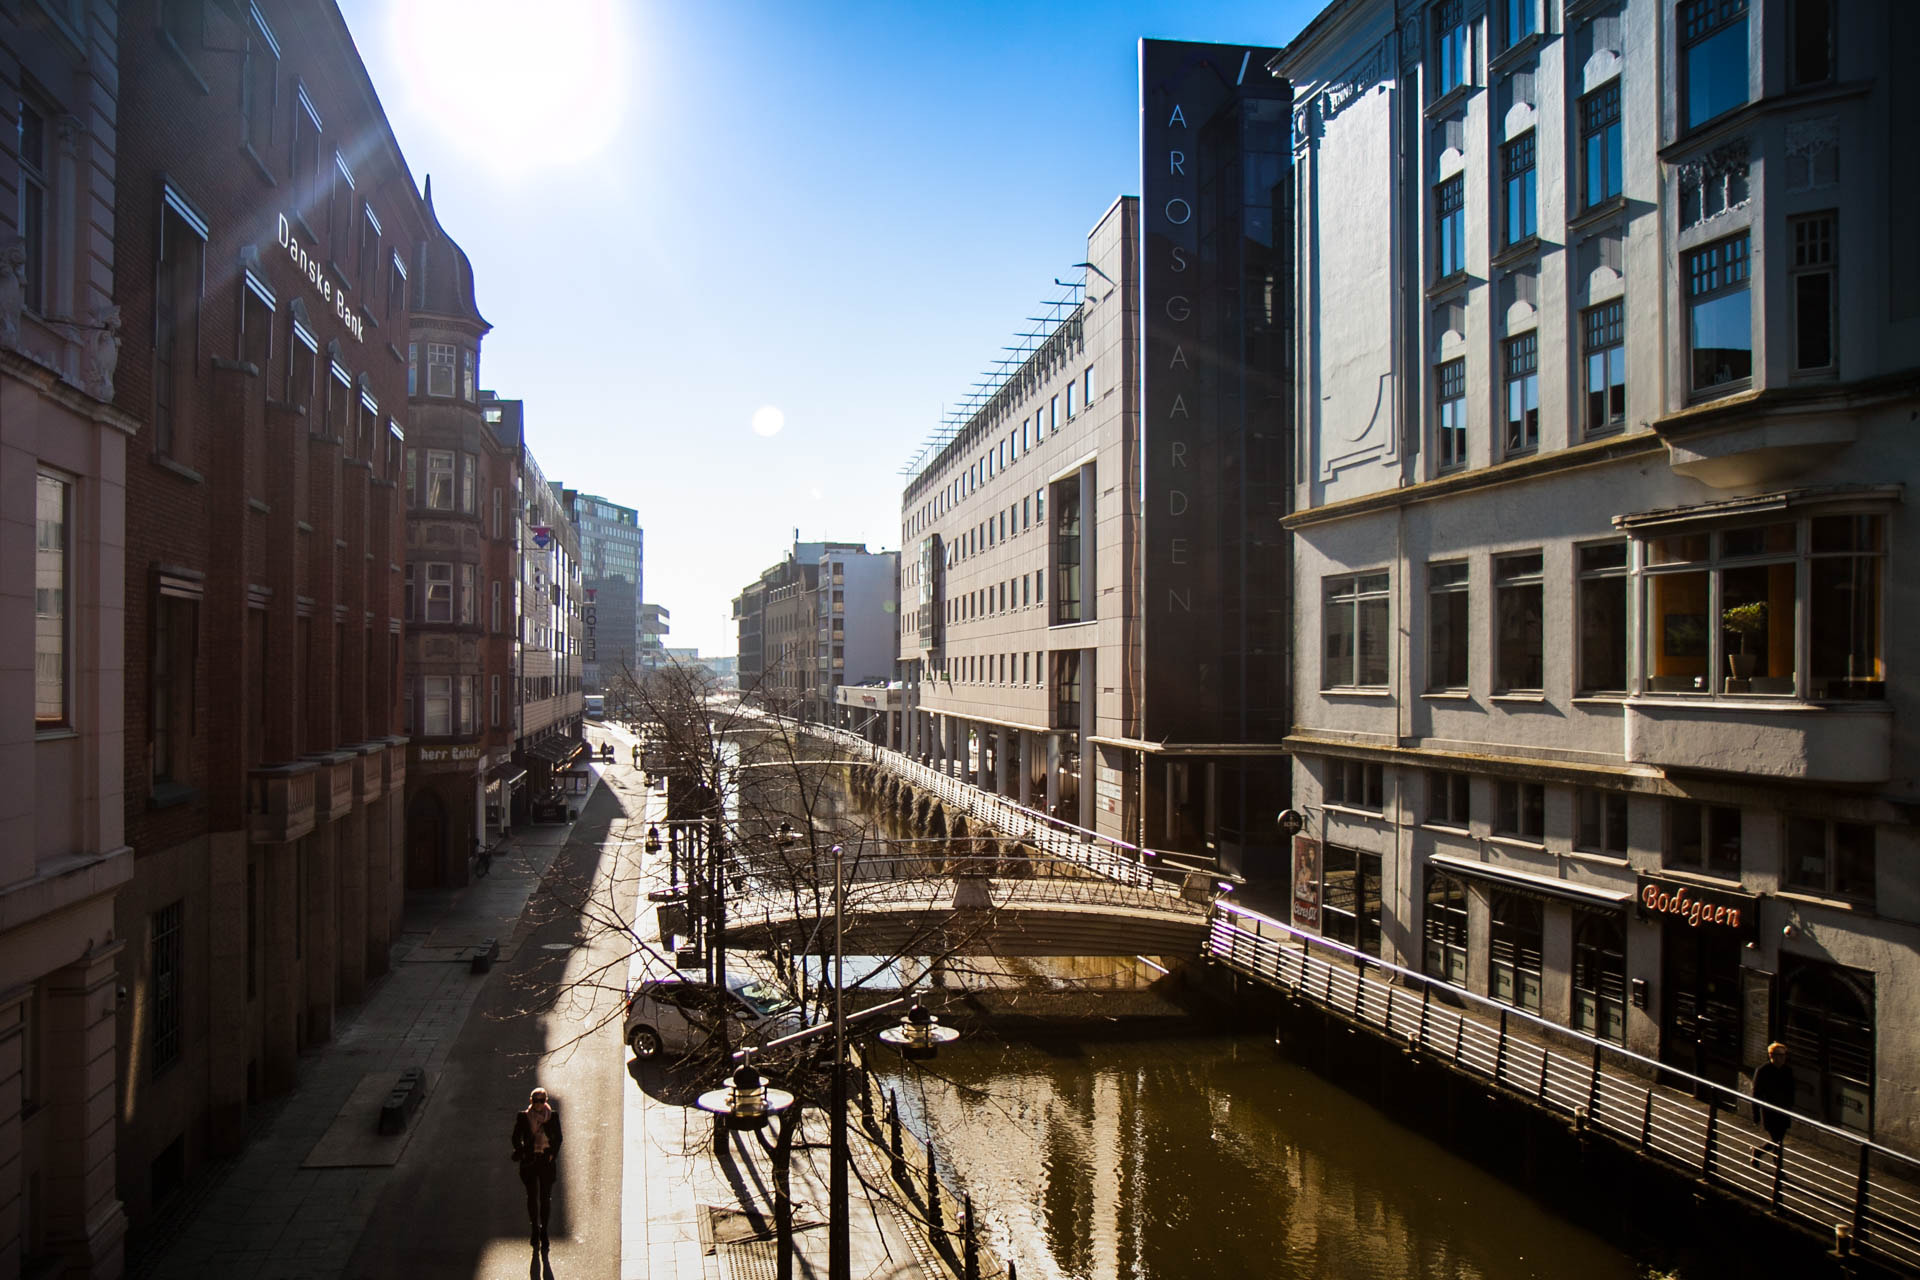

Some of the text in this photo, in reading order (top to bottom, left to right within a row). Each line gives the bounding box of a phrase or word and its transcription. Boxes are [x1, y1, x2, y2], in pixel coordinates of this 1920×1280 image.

[279, 212, 364, 343] Danske Bank
[1165, 103, 1191, 613] AROSGAARDEN
[1642, 884, 1741, 928] Bodegaen
